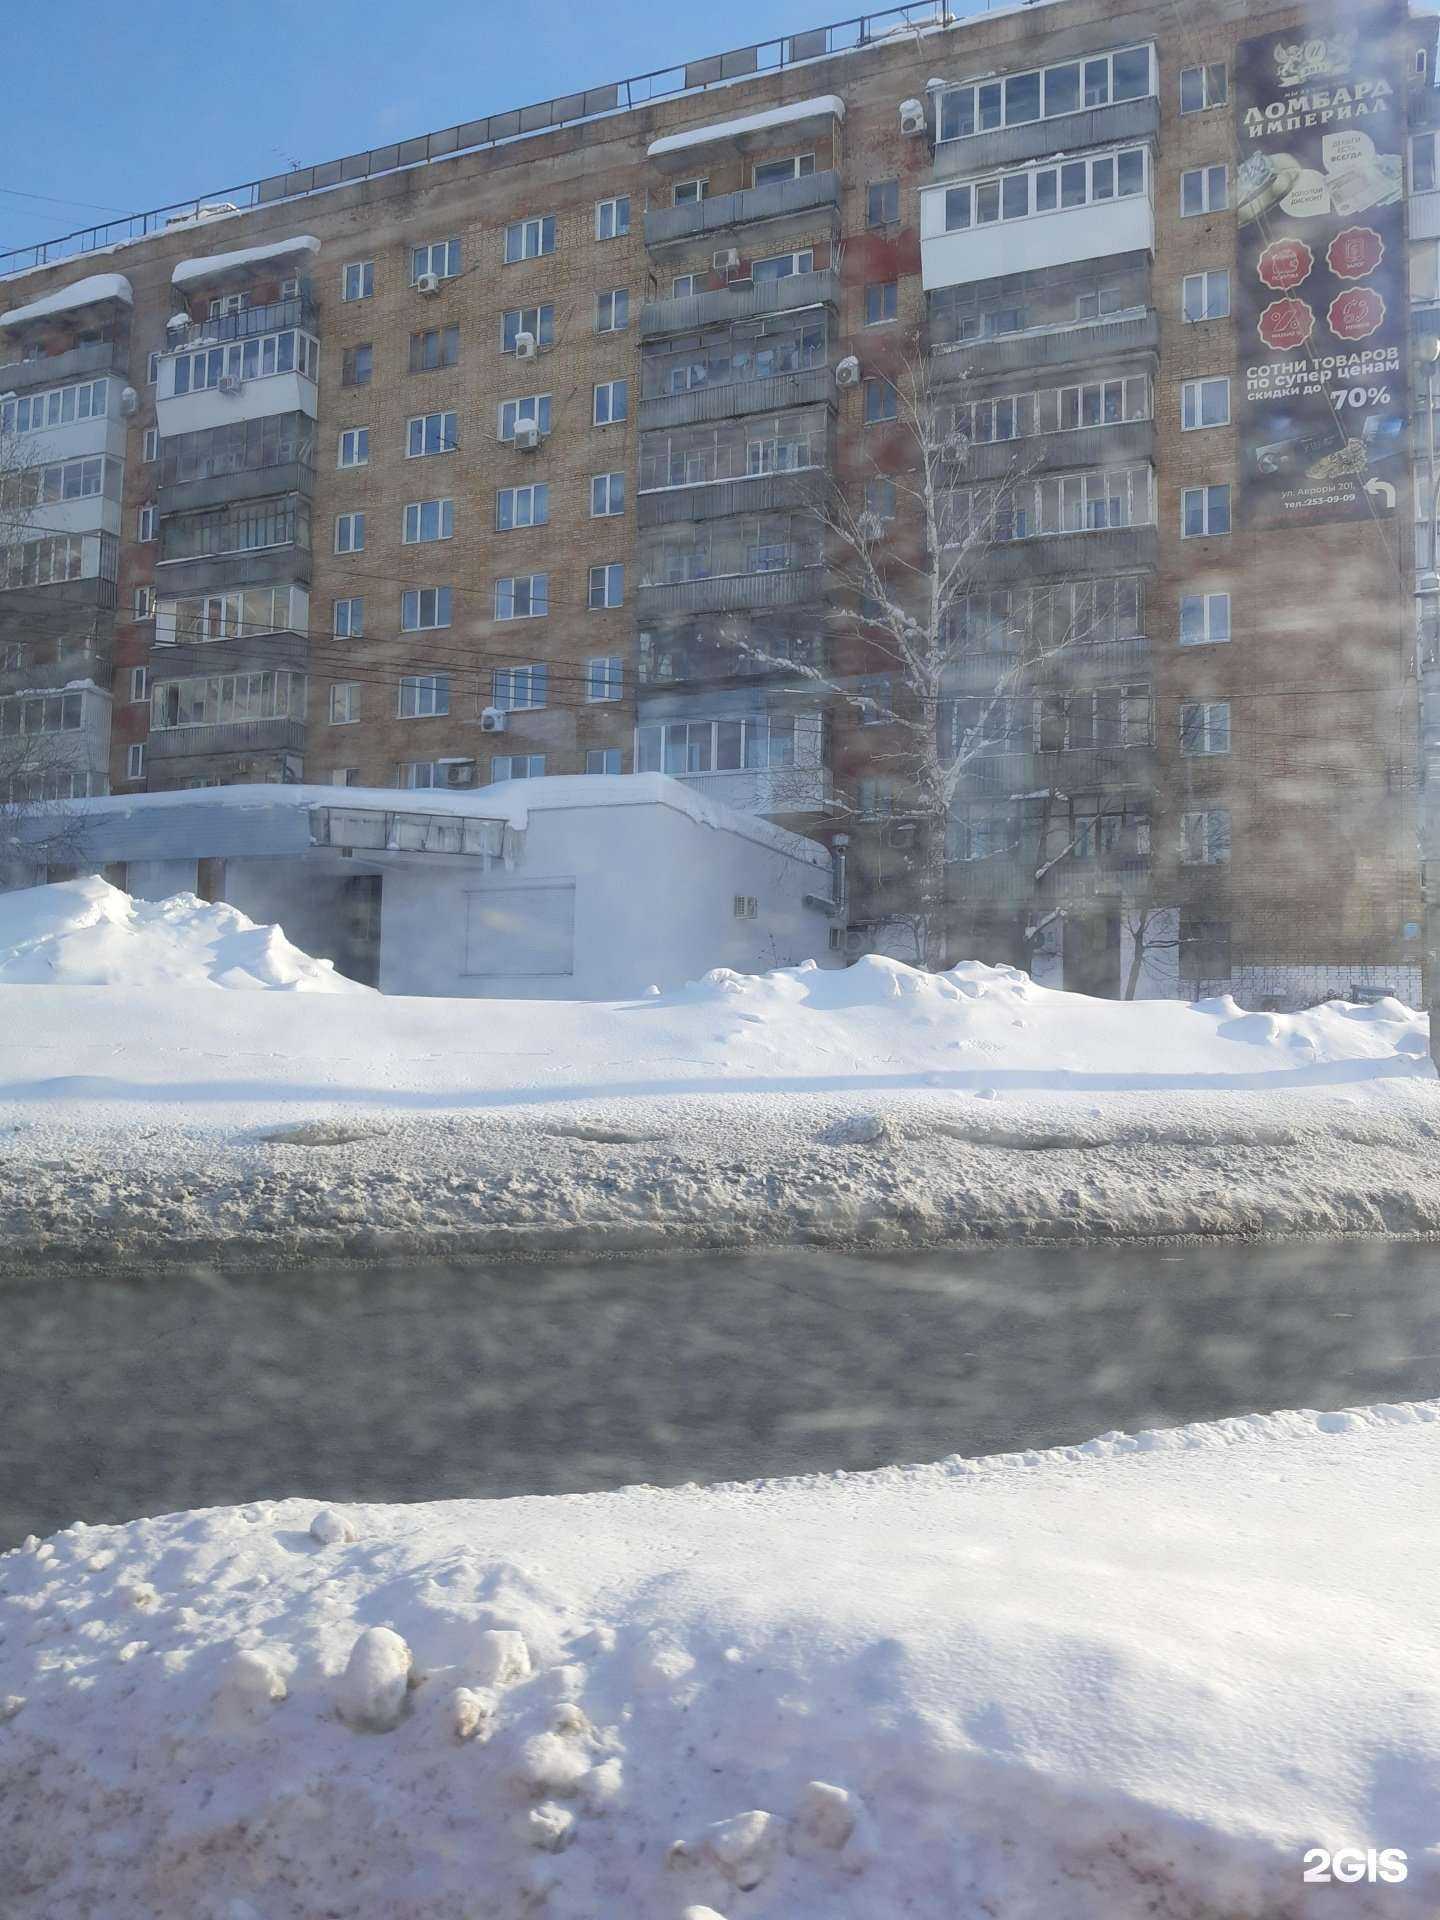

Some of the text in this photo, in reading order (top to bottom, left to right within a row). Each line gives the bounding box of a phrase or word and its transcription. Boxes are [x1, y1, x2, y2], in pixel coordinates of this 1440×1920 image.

[1244, 79, 1393, 124] ЛОМБАРД
[1249, 99, 1388, 138] ИМПЕРИАЛ
[1247, 347, 1398, 378] СОТНИ ТОВАРОВ
[1275, 370, 1332, 388] супер
[1338, 360, 1399, 380] ценам
[1247, 384, 1390, 410] скидки до 70%
